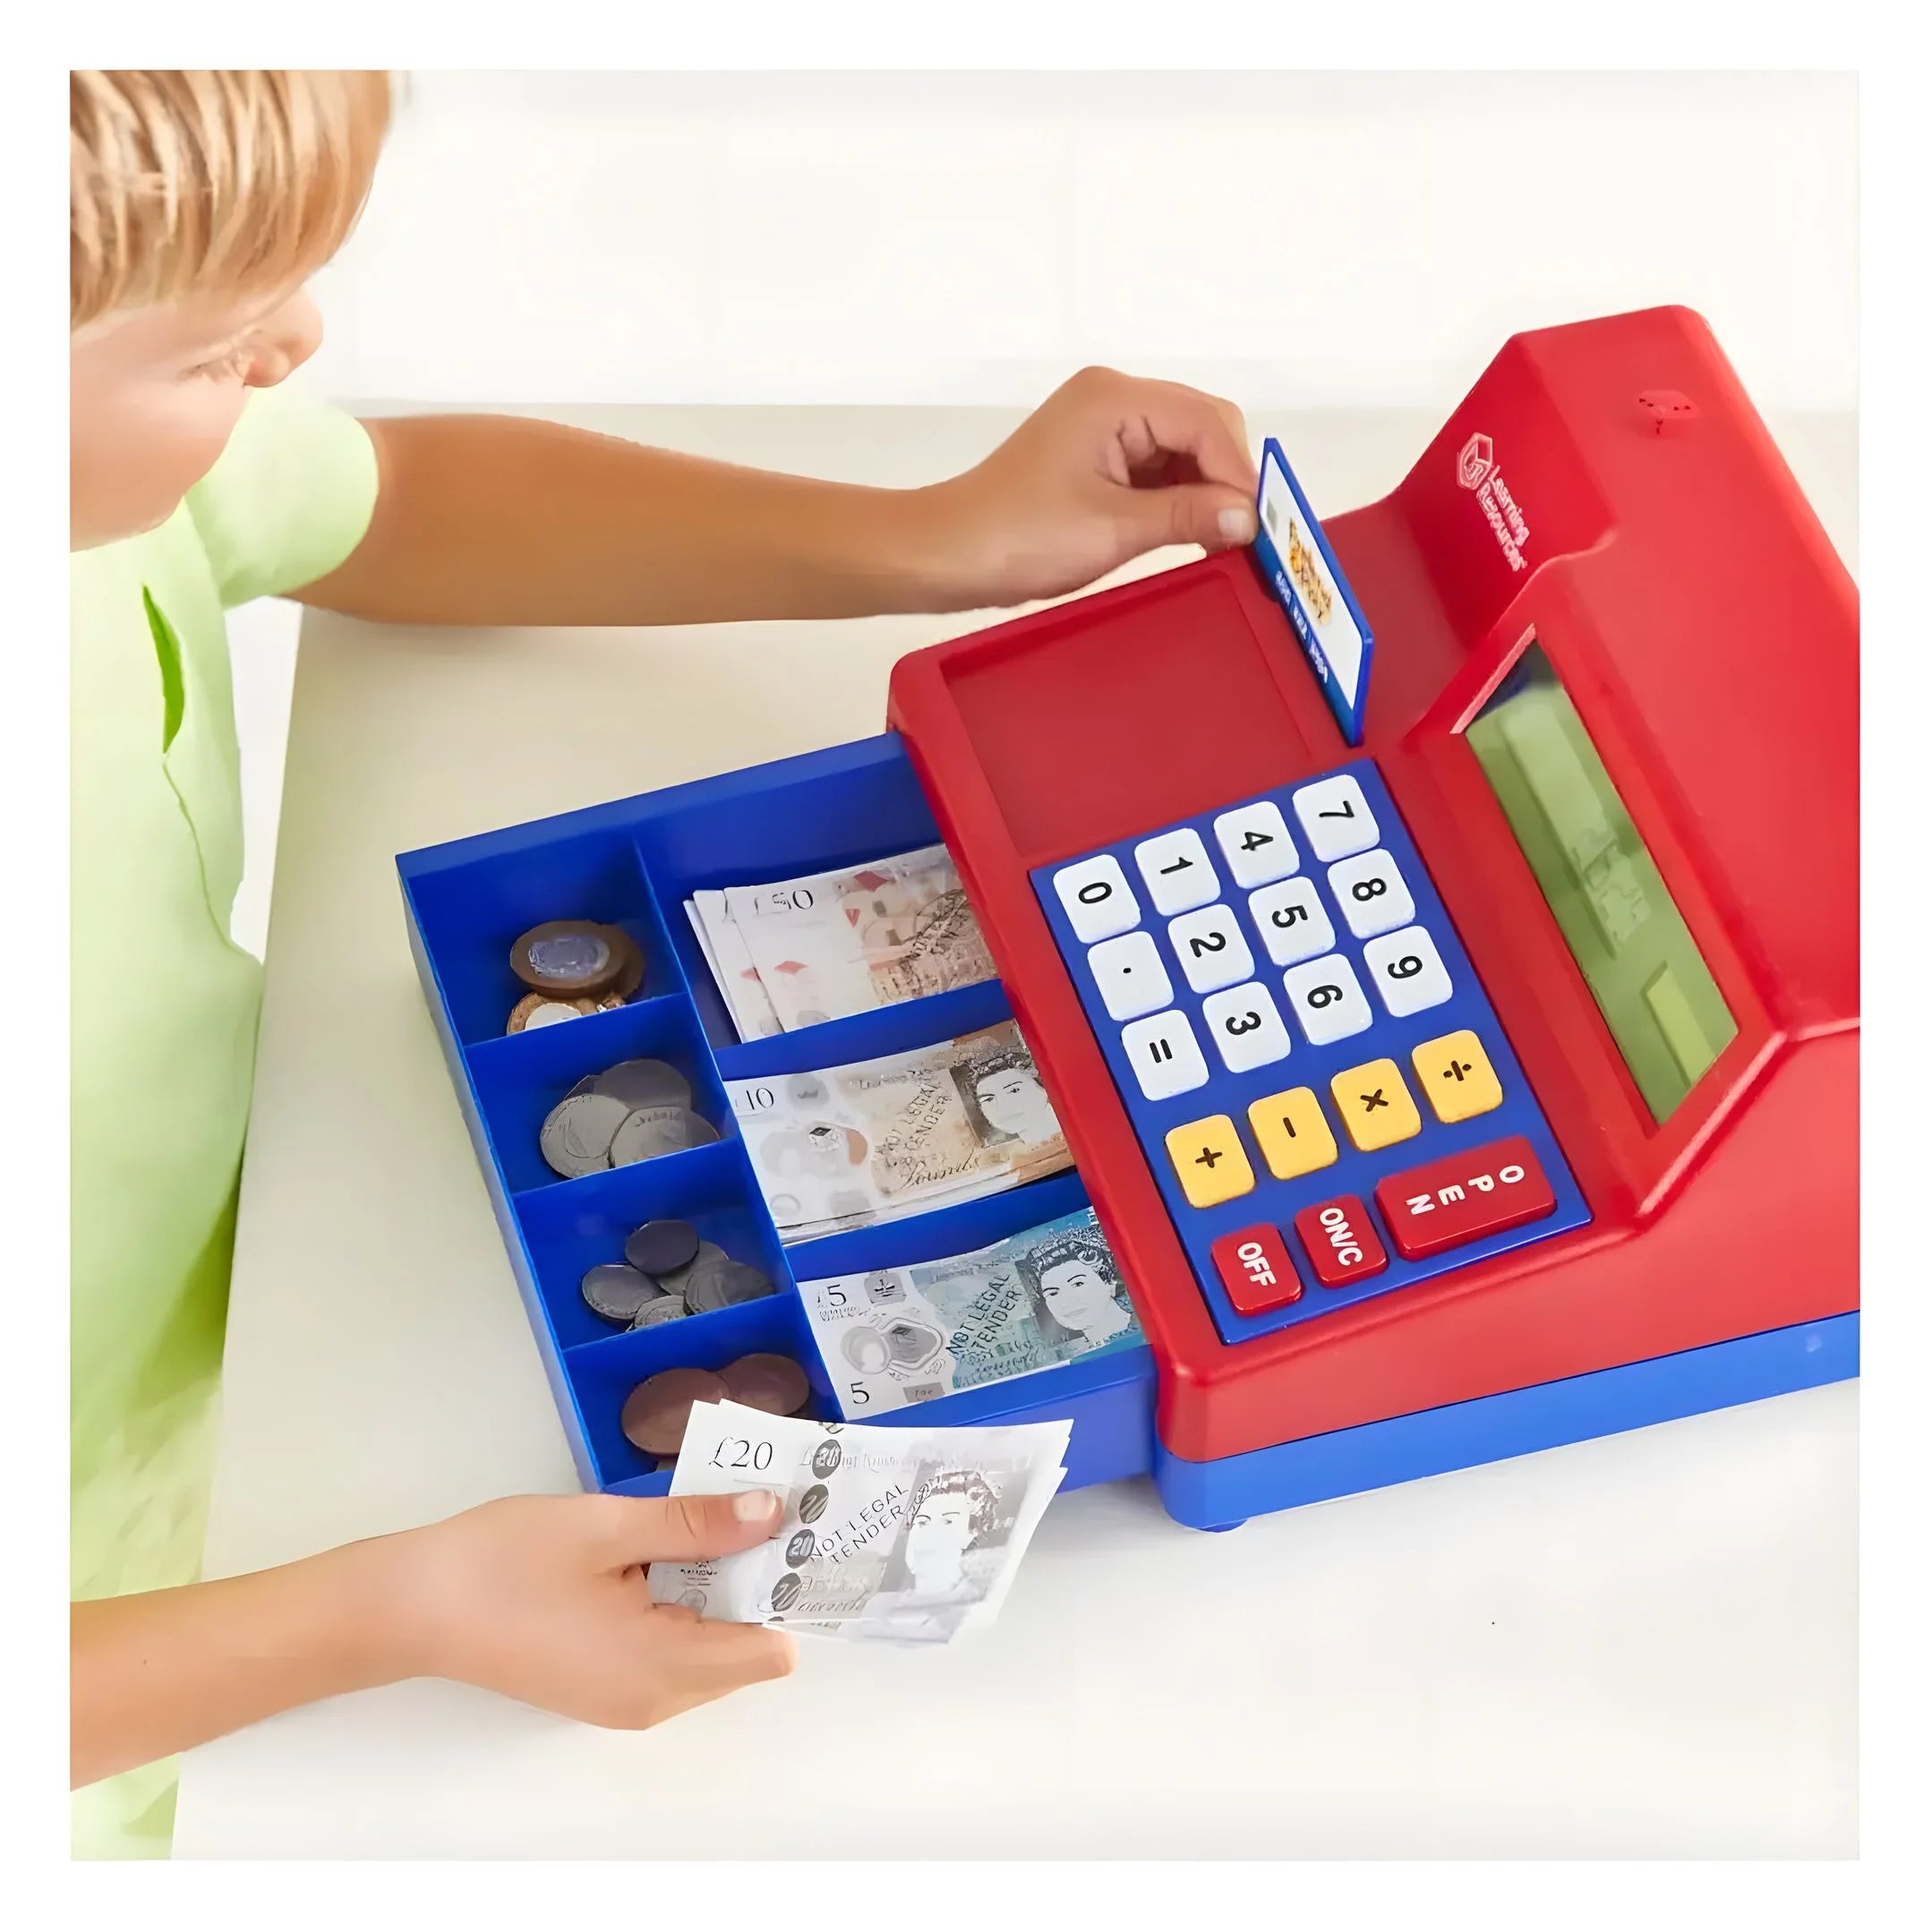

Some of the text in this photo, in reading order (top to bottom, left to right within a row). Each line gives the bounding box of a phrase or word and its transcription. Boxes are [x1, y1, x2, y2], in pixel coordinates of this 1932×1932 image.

[1488, 465, 1529, 547] Learning
[1319, 799, 1355, 820] 7
[1240, 830, 1274, 851] 4
[1159, 856, 1193, 875] 1
[1078, 882, 1113, 904] 0
[1352, 877, 1387, 902] 8
[1271, 905, 1309, 928] 5
[1189, 932, 1227, 958] 2
[1387, 955, 1423, 979] 9
[1307, 984, 1343, 1009] 6
[1225, 1011, 1261, 1036] 3
[1406, 1165, 1525, 1215] OPEN
[1320, 1208, 1364, 1266] ON/C
[1237, 1242, 1277, 1287] OFF
[945, 1322, 974, 1355] NOT
[968, 1274, 1011, 1321] LEGAL
[970, 1289, 1022, 1350] TENDER
[850, 1381, 869, 1405] 5
[708, 1436, 774, 1471] £20
[810, 1483, 910, 1562] NOT LEGAL
[830, 1504, 906, 1565] TENDER
